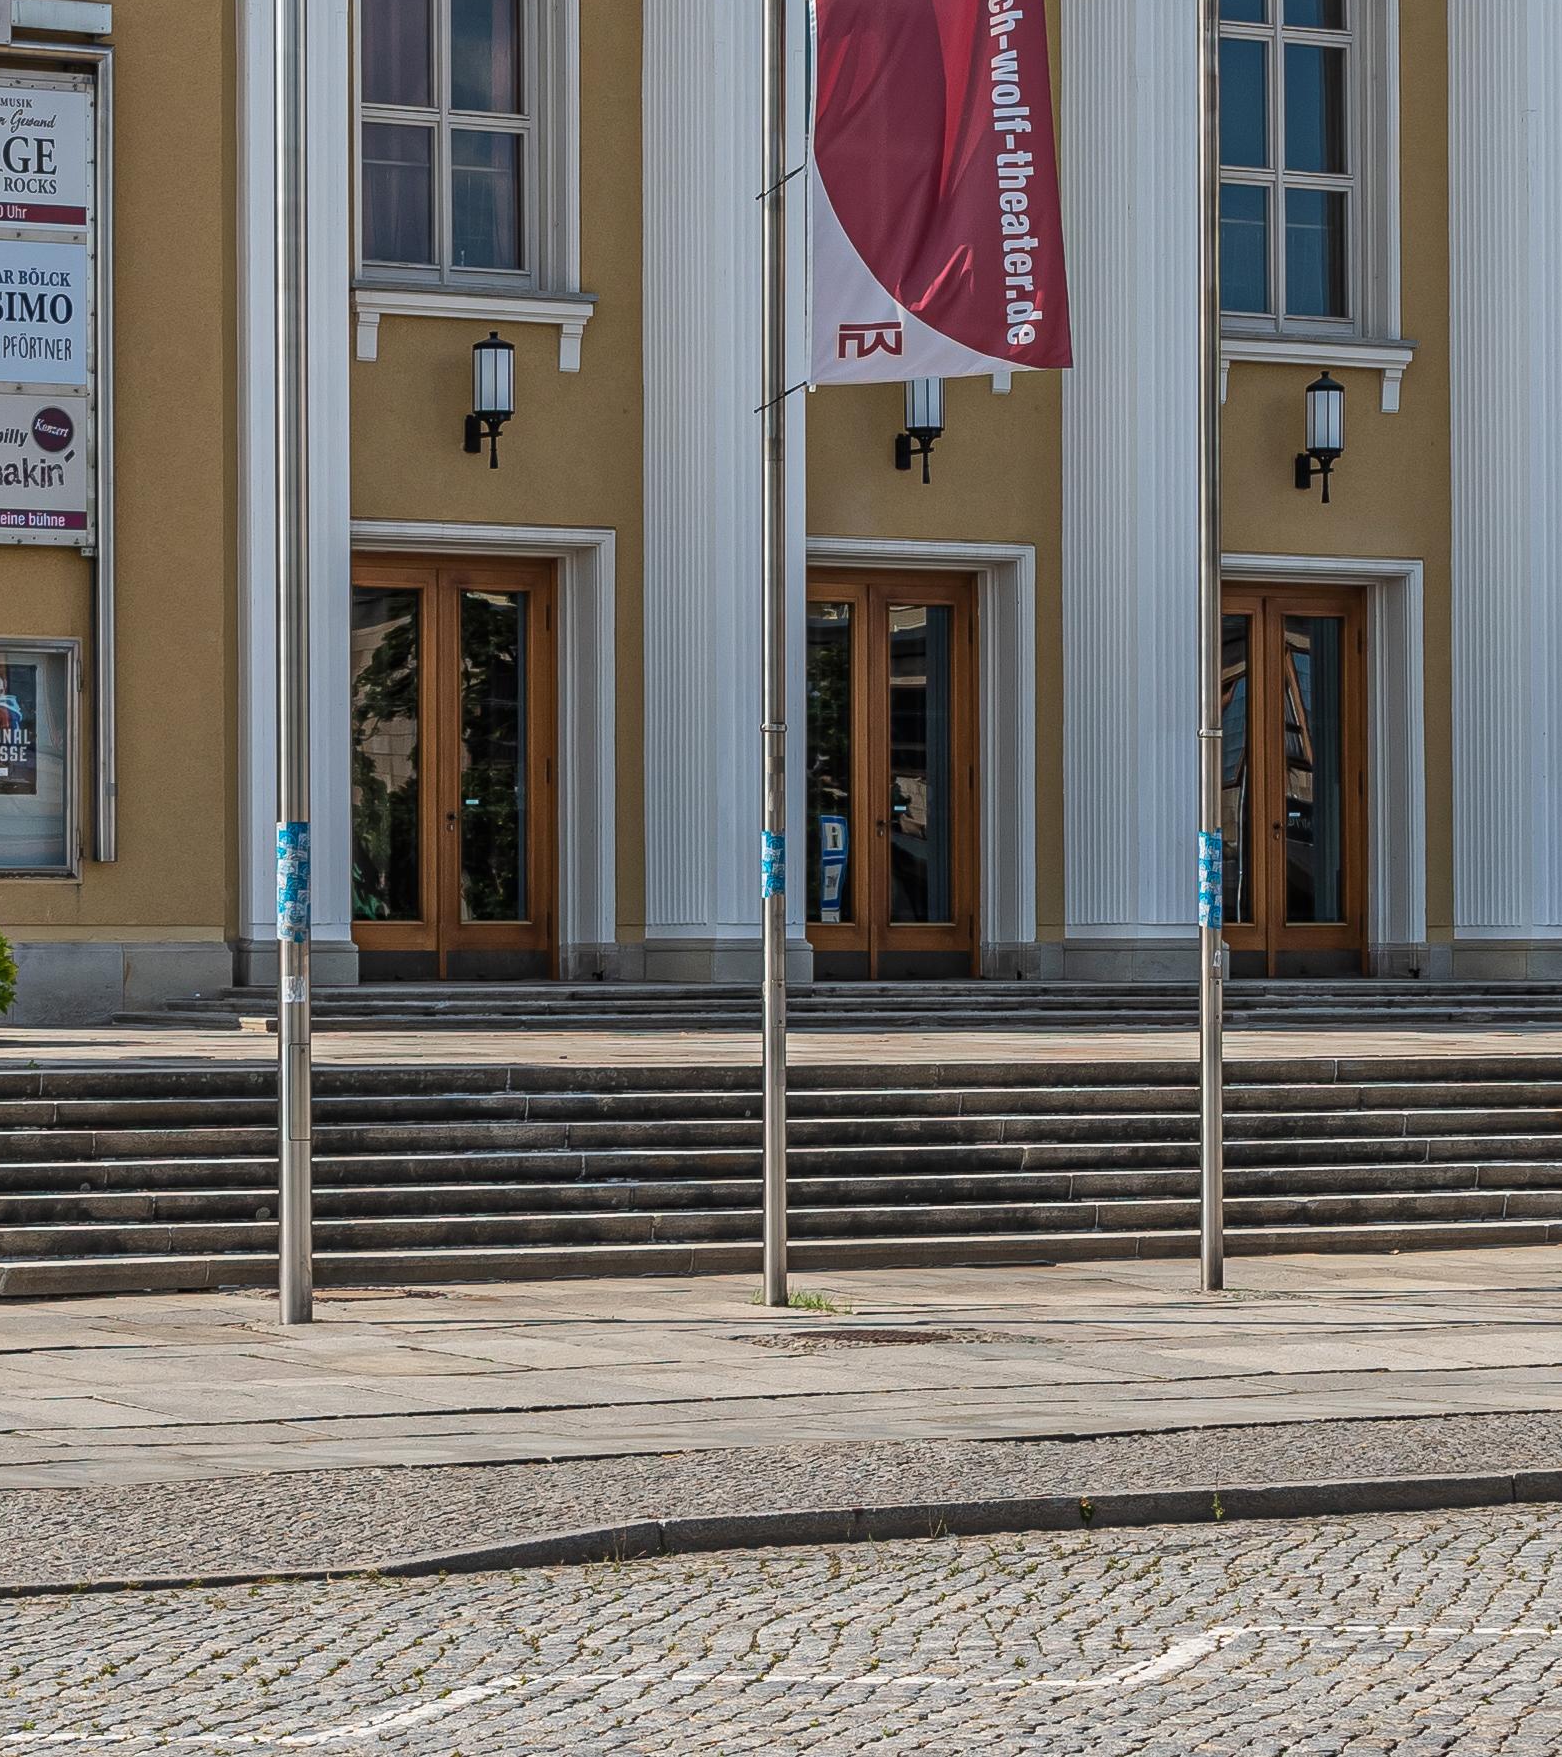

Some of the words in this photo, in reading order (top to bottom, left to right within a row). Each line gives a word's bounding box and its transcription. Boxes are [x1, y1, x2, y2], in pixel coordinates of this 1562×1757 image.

[10, 109, 57, 133] Gewand
[4, 177, 57, 194] ROCKS
[7, 204, 27, 219] Uhr
[18, 268, 71, 287] BÖLCK
[3, 333, 72, 361] PFÖRTNER
[29, 512, 66, 526] bühne
